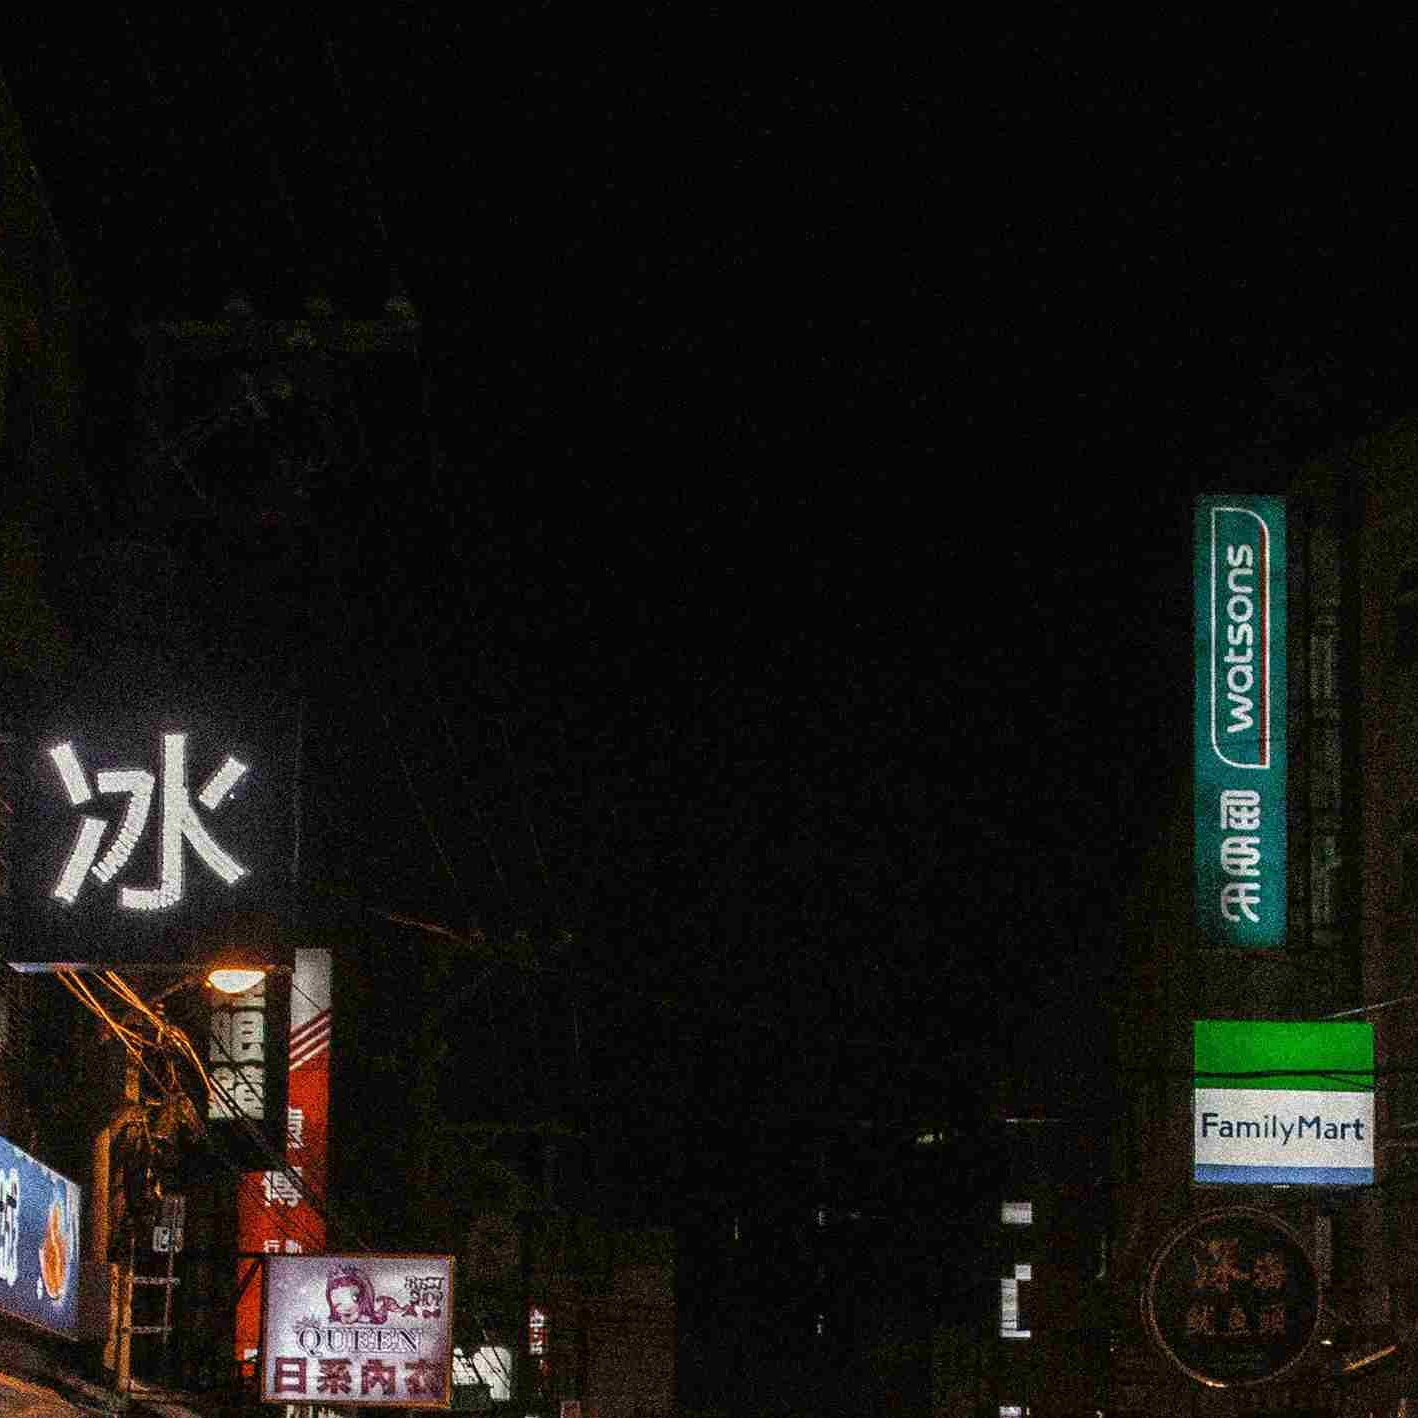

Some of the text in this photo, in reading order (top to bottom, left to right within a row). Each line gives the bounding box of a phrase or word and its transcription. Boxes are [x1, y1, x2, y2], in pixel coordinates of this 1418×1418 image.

[1226, 542, 1253, 734] watsons
[49, 732, 248, 912] 冰
[1200, 1111, 1365, 1146] FamilyMart
[296, 1326, 422, 1357] QUEEN
[275, 1356, 443, 1395] 日系內衣
